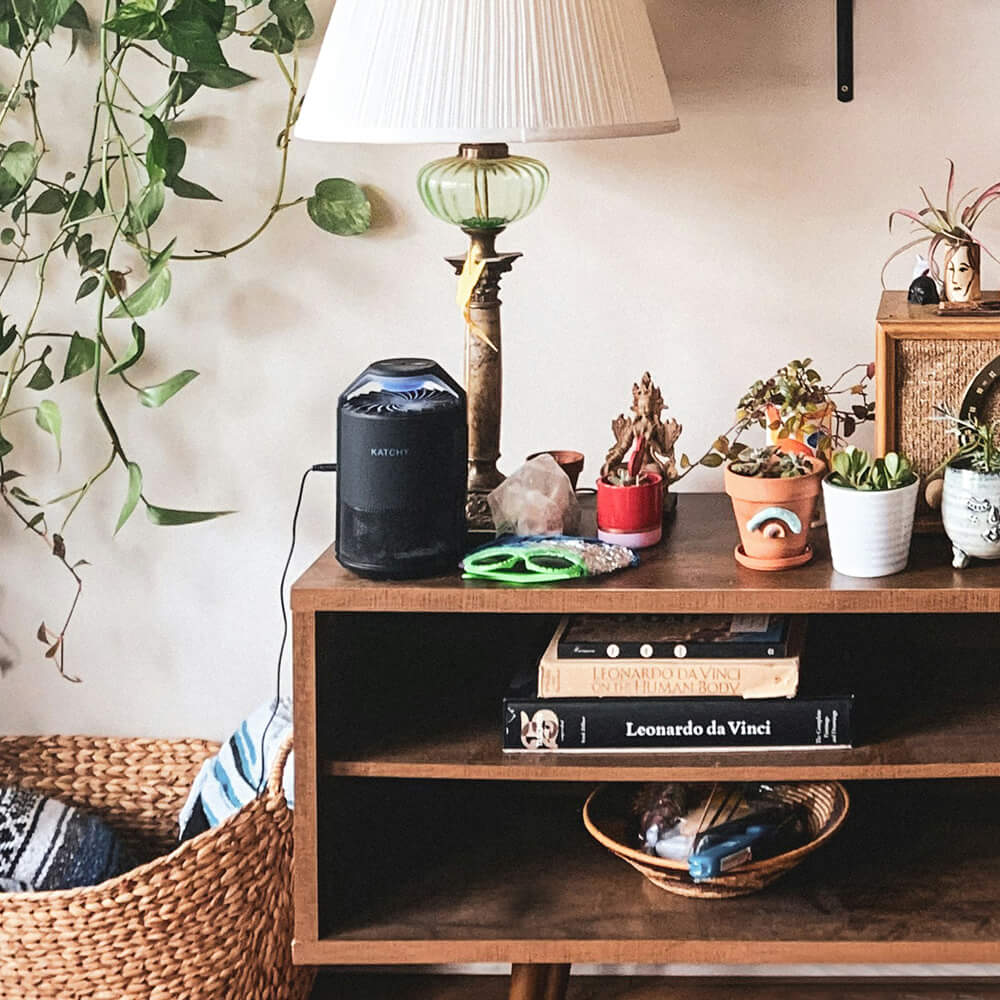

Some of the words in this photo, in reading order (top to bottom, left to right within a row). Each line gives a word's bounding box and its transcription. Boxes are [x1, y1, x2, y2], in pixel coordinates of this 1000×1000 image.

[592, 666, 674, 681] LEONARDO
[678, 666, 697, 681] DA
[698, 666, 741, 681] VINCI
[635, 680, 693, 694] HUMAN
[698, 680, 739, 694] BODY
[626, 720, 703, 736] Leonardo
[706, 720, 725, 736] da
[727, 720, 771, 736] Vinci
